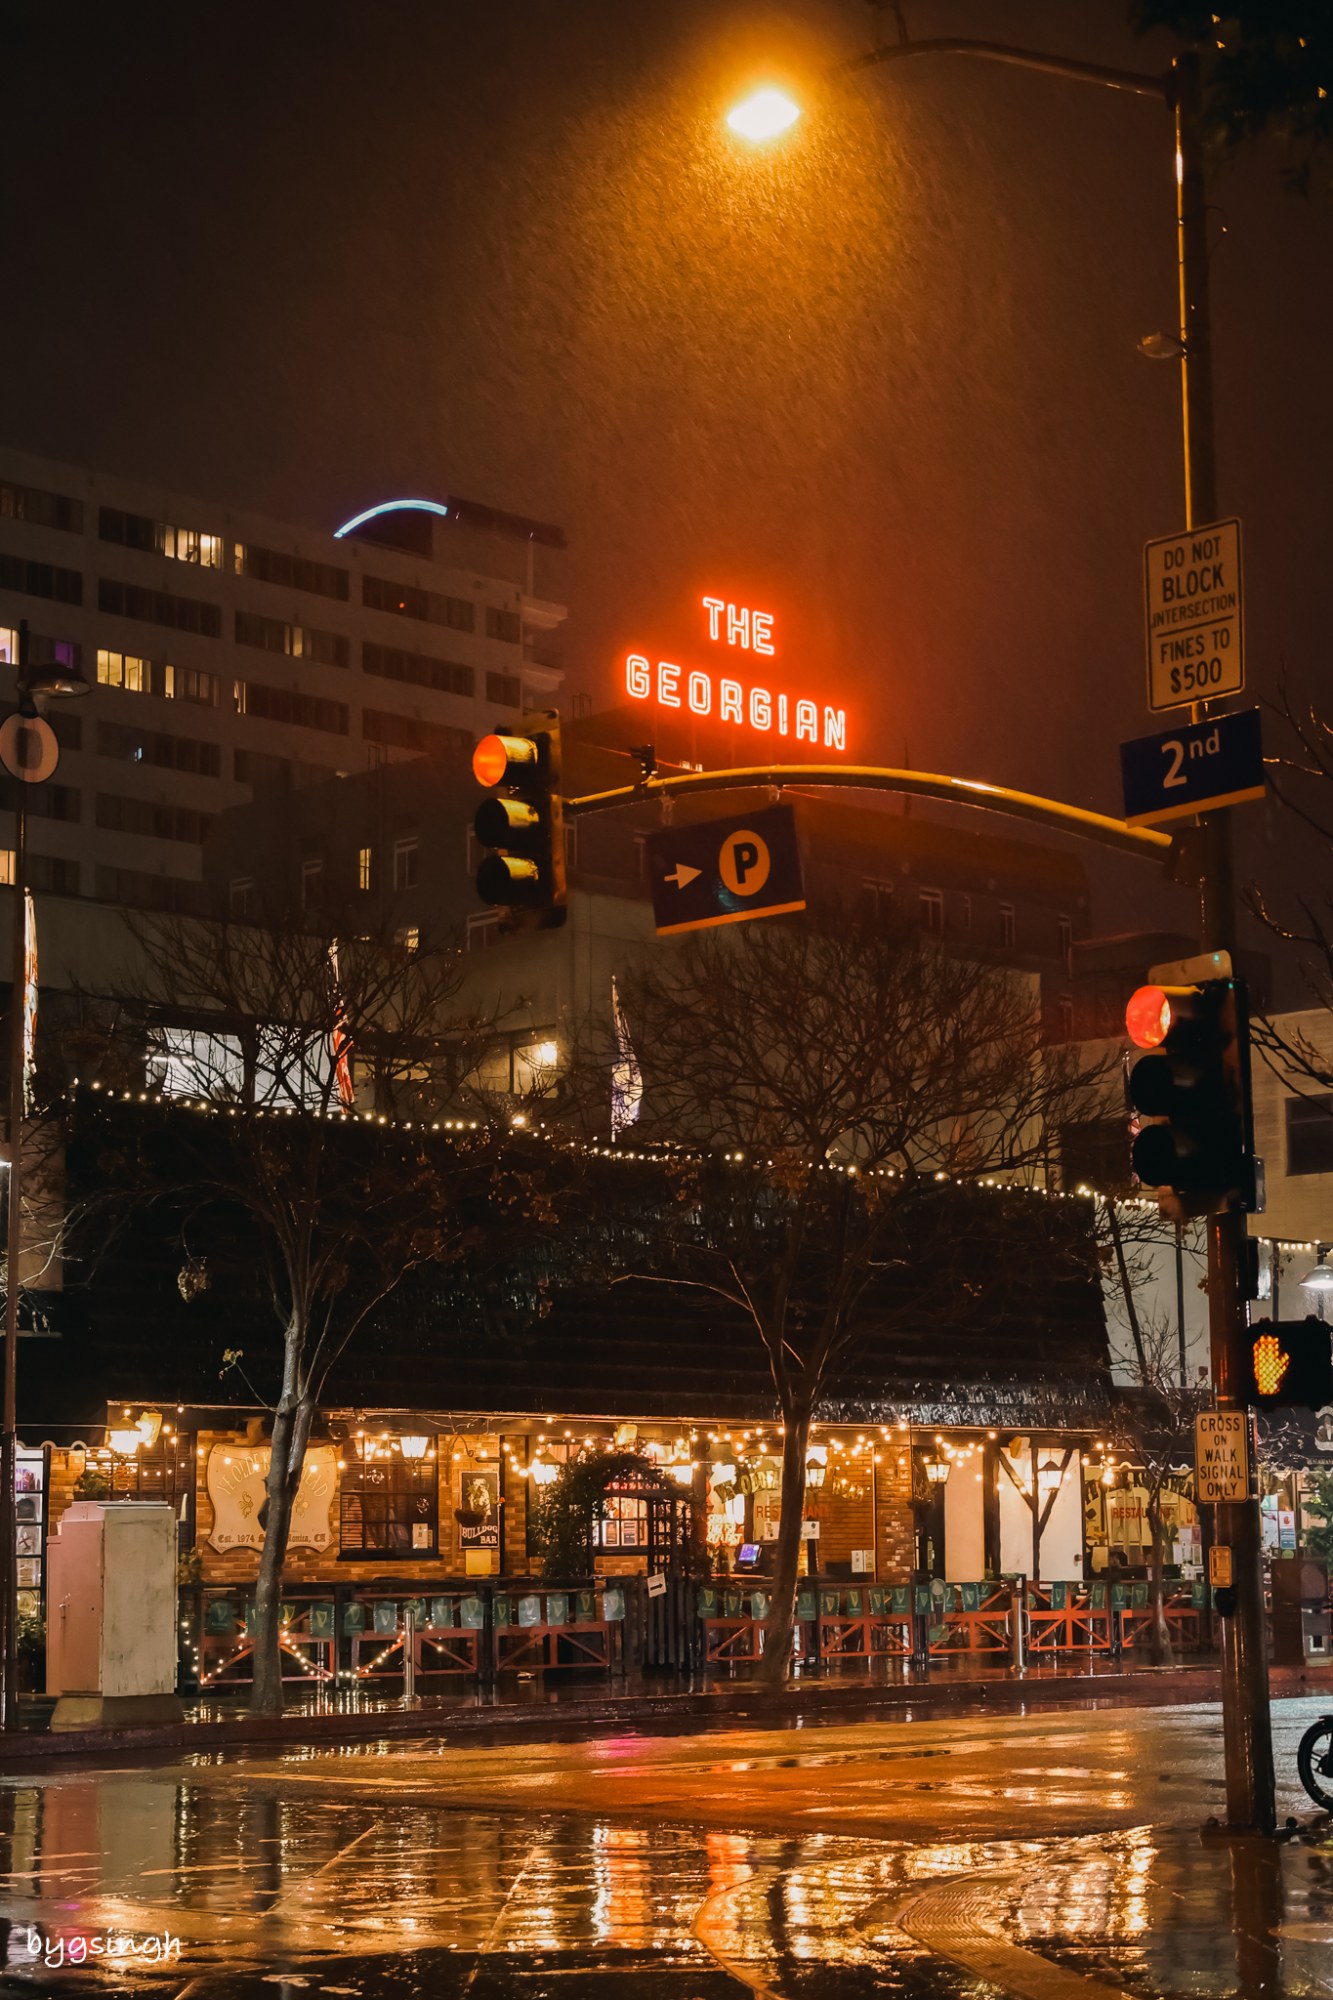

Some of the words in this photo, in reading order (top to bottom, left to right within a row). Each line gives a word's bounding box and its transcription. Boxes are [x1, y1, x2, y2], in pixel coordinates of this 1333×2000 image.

[1164, 546, 1185, 570] DO
[1191, 536, 1221, 562] NOT
[1162, 563, 1225, 603] BLOCK
[702, 596, 775, 656] THE
[1152, 592, 1236, 628] INTERSECTION
[1160, 635, 1205, 664] FINES
[1212, 627, 1230, 652] TO
[1170, 657, 1223, 694] $500
[626, 653, 846, 751] GEORGIAN
[1161, 728, 1221, 788] 2nd
[733, 842, 758, 884] P
[1200, 1417, 1240, 1432] CROSS
[1213, 1434, 1227, 1446] ON
[1205, 1448, 1237, 1462] WALK
[1200, 1465, 1244, 1480] SIGNAL
[1207, 1481, 1237, 1496] ONLY
[237, 1534, 255, 1543] 1974
[462, 1525, 498, 1539] BULLDOG
[480, 1535, 497, 1544] BAR
